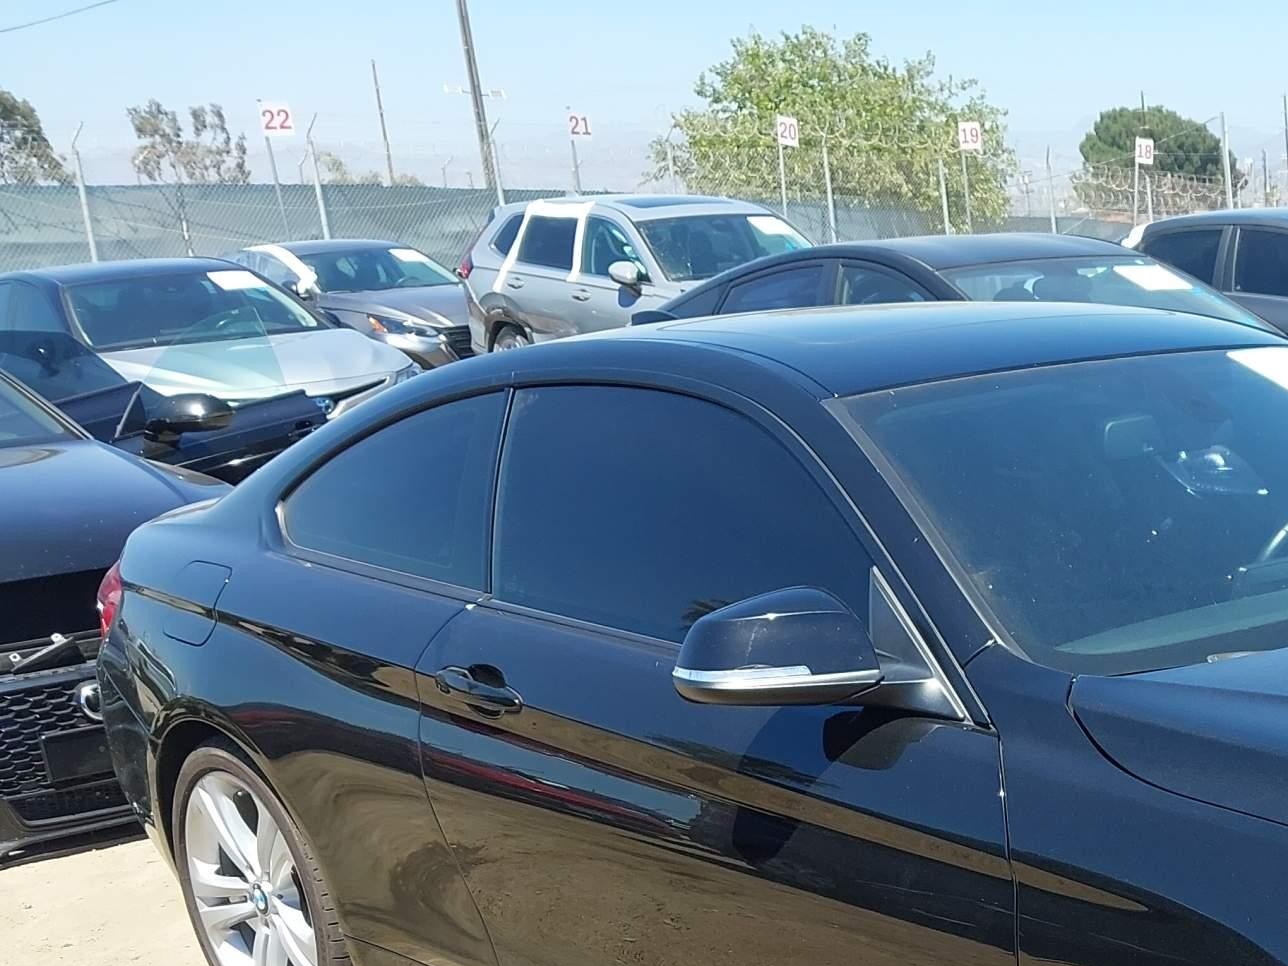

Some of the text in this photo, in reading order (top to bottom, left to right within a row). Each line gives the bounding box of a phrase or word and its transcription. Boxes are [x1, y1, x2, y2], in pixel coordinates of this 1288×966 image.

[262, 109, 292, 130] 22
[569, 116, 592, 135] 21
[778, 122, 797, 140] 20
[960, 127, 979, 144] 19
[1137, 144, 1152, 160] 18
